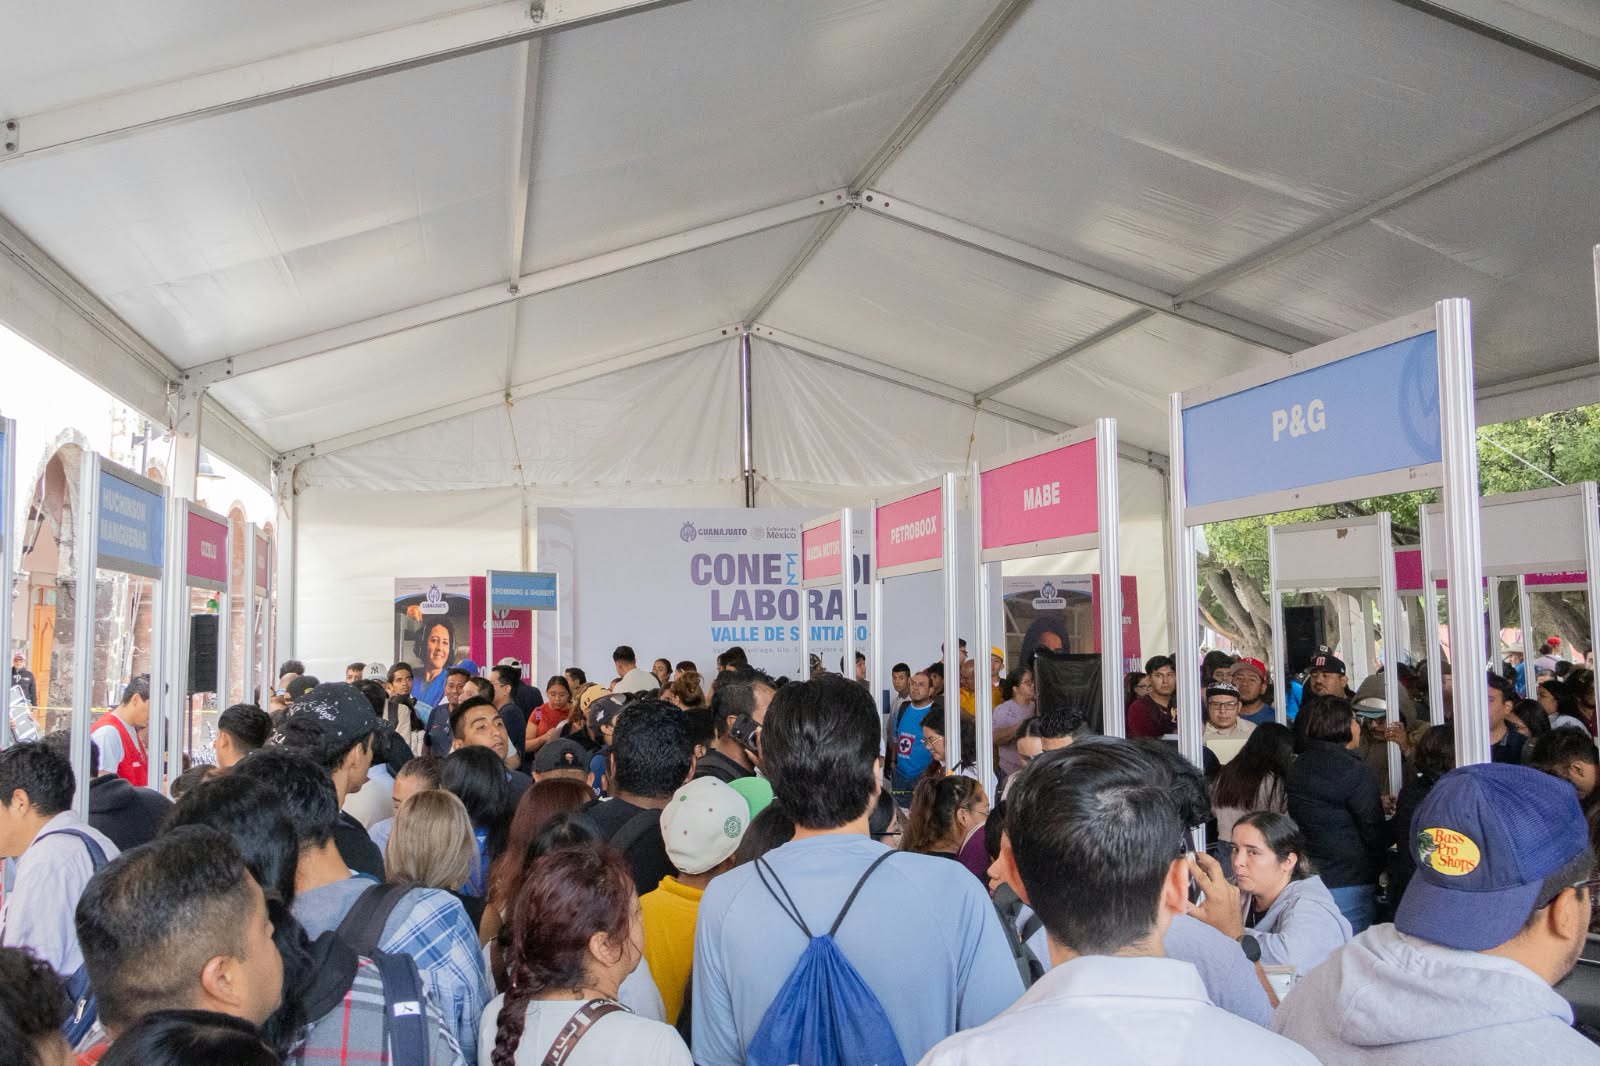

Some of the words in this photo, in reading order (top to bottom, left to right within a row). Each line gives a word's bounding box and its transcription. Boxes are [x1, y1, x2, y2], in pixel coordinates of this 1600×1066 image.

[1271, 398, 1326, 442] P&G
[1023, 481, 1060, 511] MABE
[698, 527, 748, 536] GUANAJUATO
[890, 515, 937, 544] PETROBOOX
[712, 626, 759, 642] VALLE
[764, 626, 785, 641] DE
[790, 625, 868, 641] SNTIAO
[1435, 829, 1465, 844] Bass
[1437, 843, 1458, 856] Pro
[1439, 854, 1476, 873] Shops
